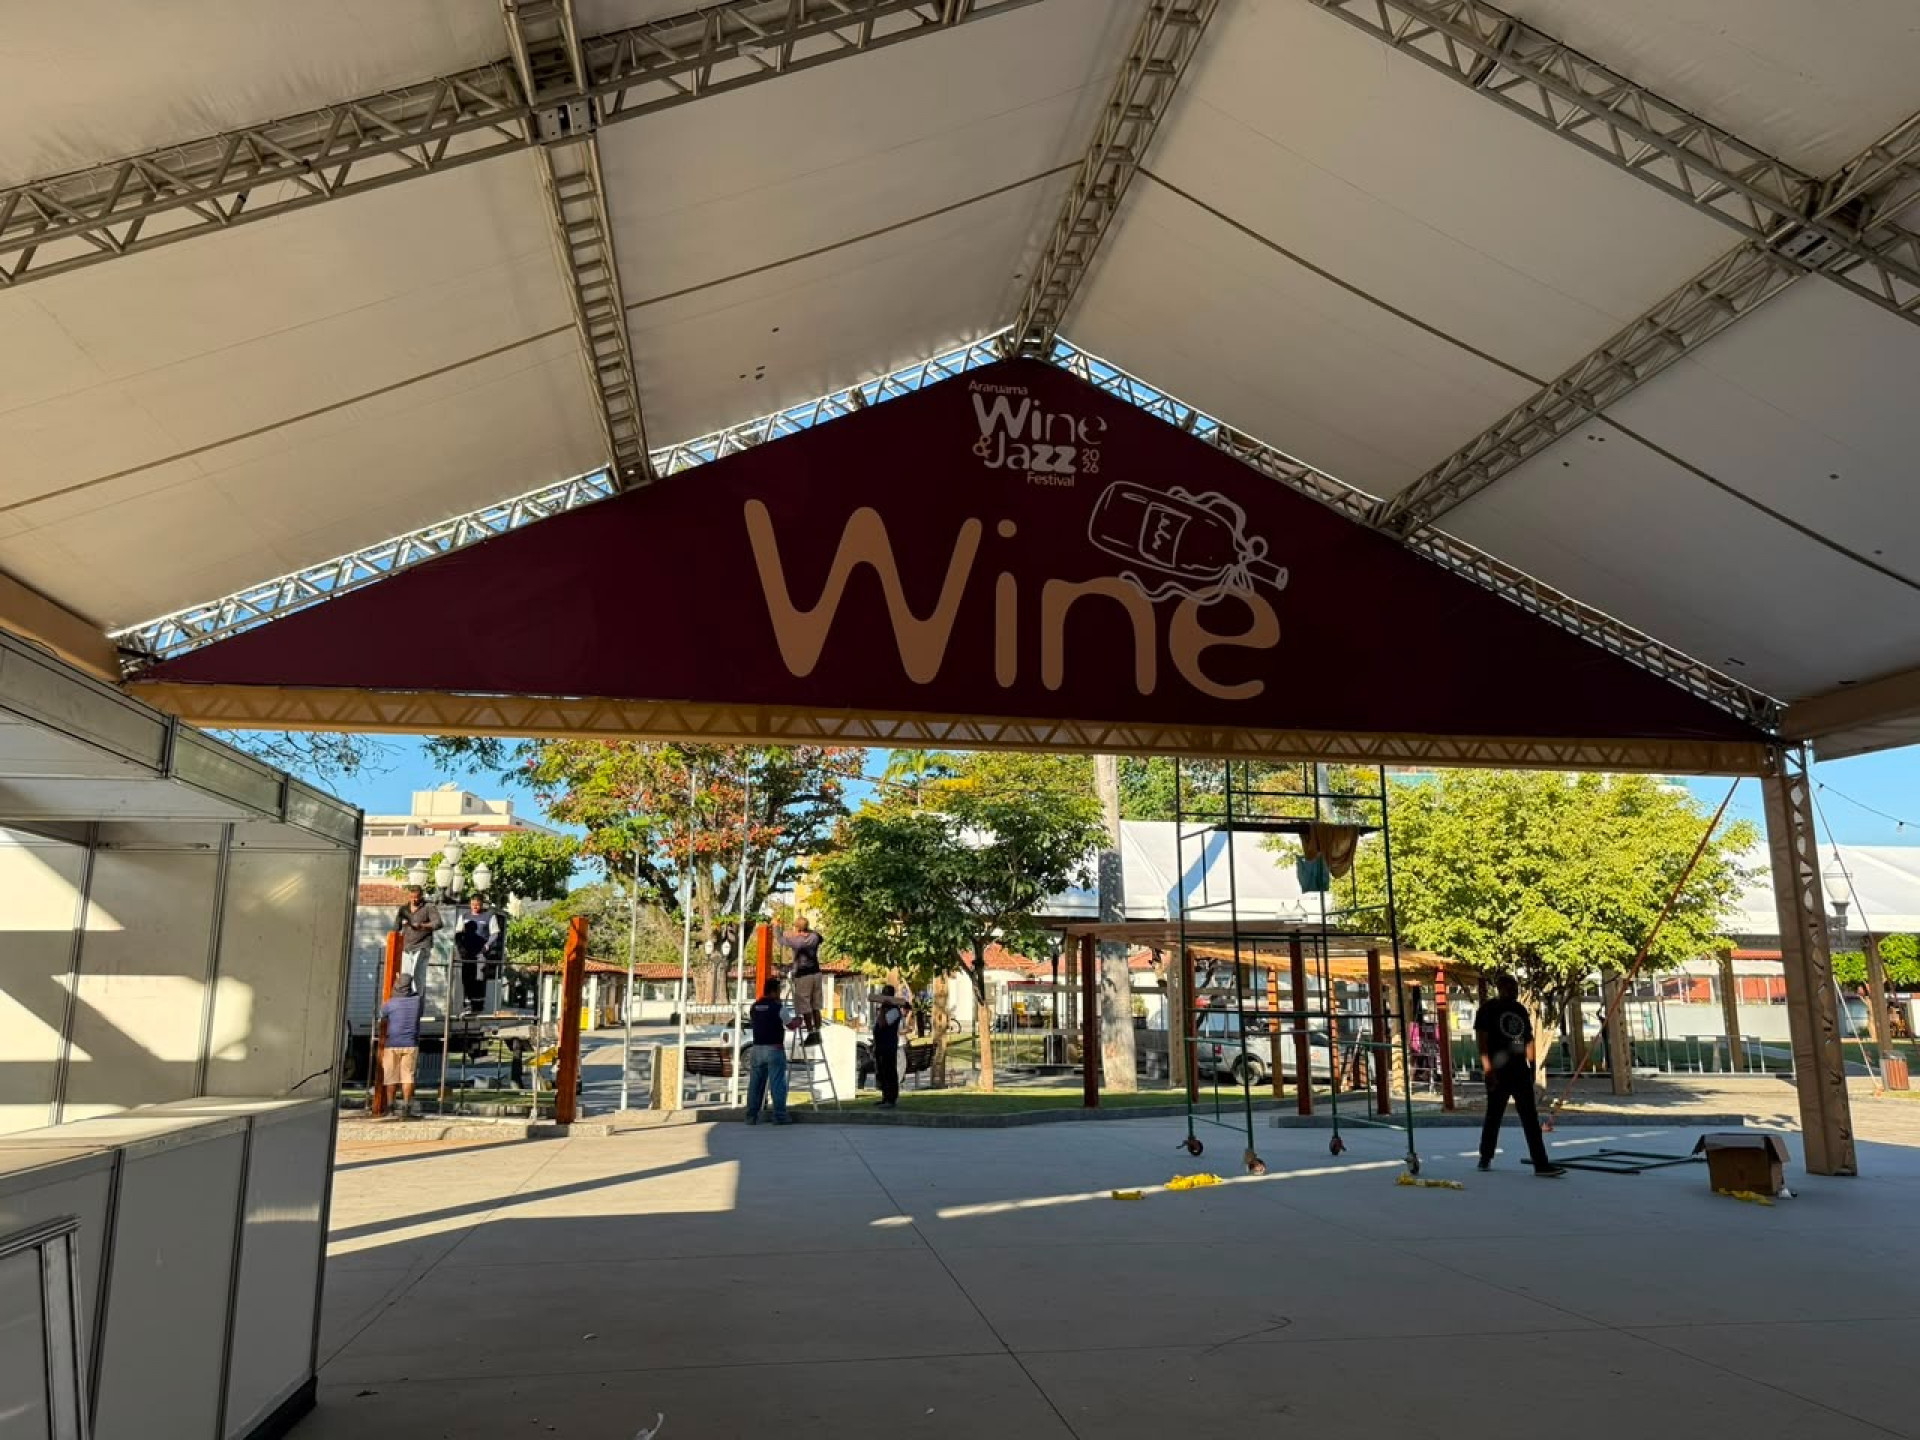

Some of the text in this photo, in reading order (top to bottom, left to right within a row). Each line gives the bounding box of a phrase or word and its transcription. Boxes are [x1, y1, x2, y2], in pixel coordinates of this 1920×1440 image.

[968, 380, 1028, 395] Araruama
[972, 393, 1108, 444] Wine
[972, 431, 1077, 474] & Jazz
[1027, 471, 1075, 488] Festival
[744, 499, 1281, 700] Wine
